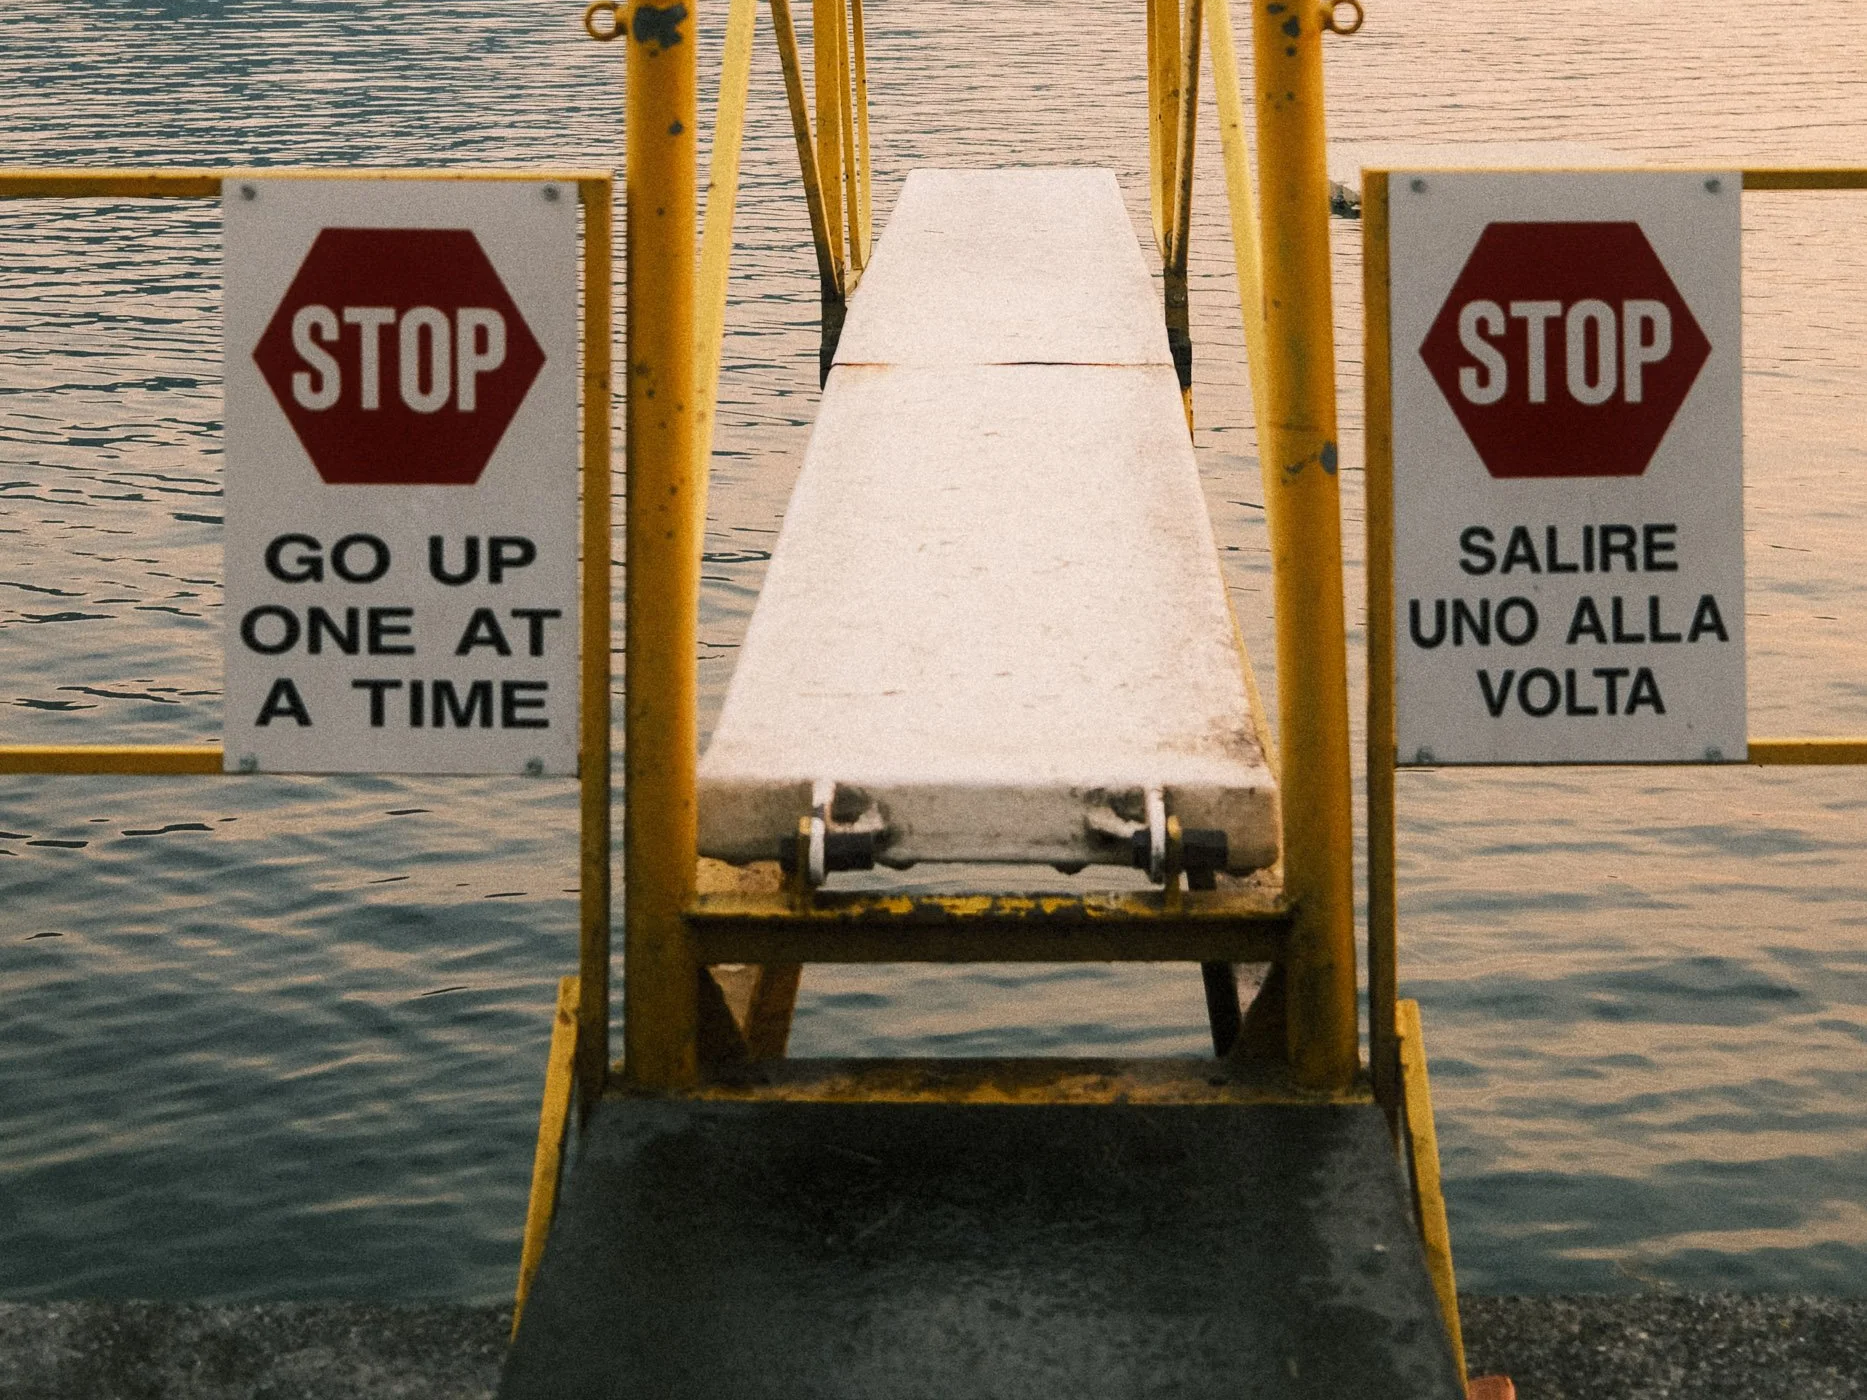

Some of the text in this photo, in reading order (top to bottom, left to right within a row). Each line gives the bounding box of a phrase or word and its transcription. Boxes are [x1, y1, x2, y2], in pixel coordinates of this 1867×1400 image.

[292, 304, 507, 413] STOP
[1457, 298, 1672, 406] STOP
[264, 532, 538, 586] GO UP
[1458, 523, 1679, 576] SALIRE
[239, 604, 562, 657] ONE AT
[1407, 594, 1730, 649] UNO ALLA
[254, 677, 550, 729] A TIME
[1476, 666, 1667, 718] VOLTA
